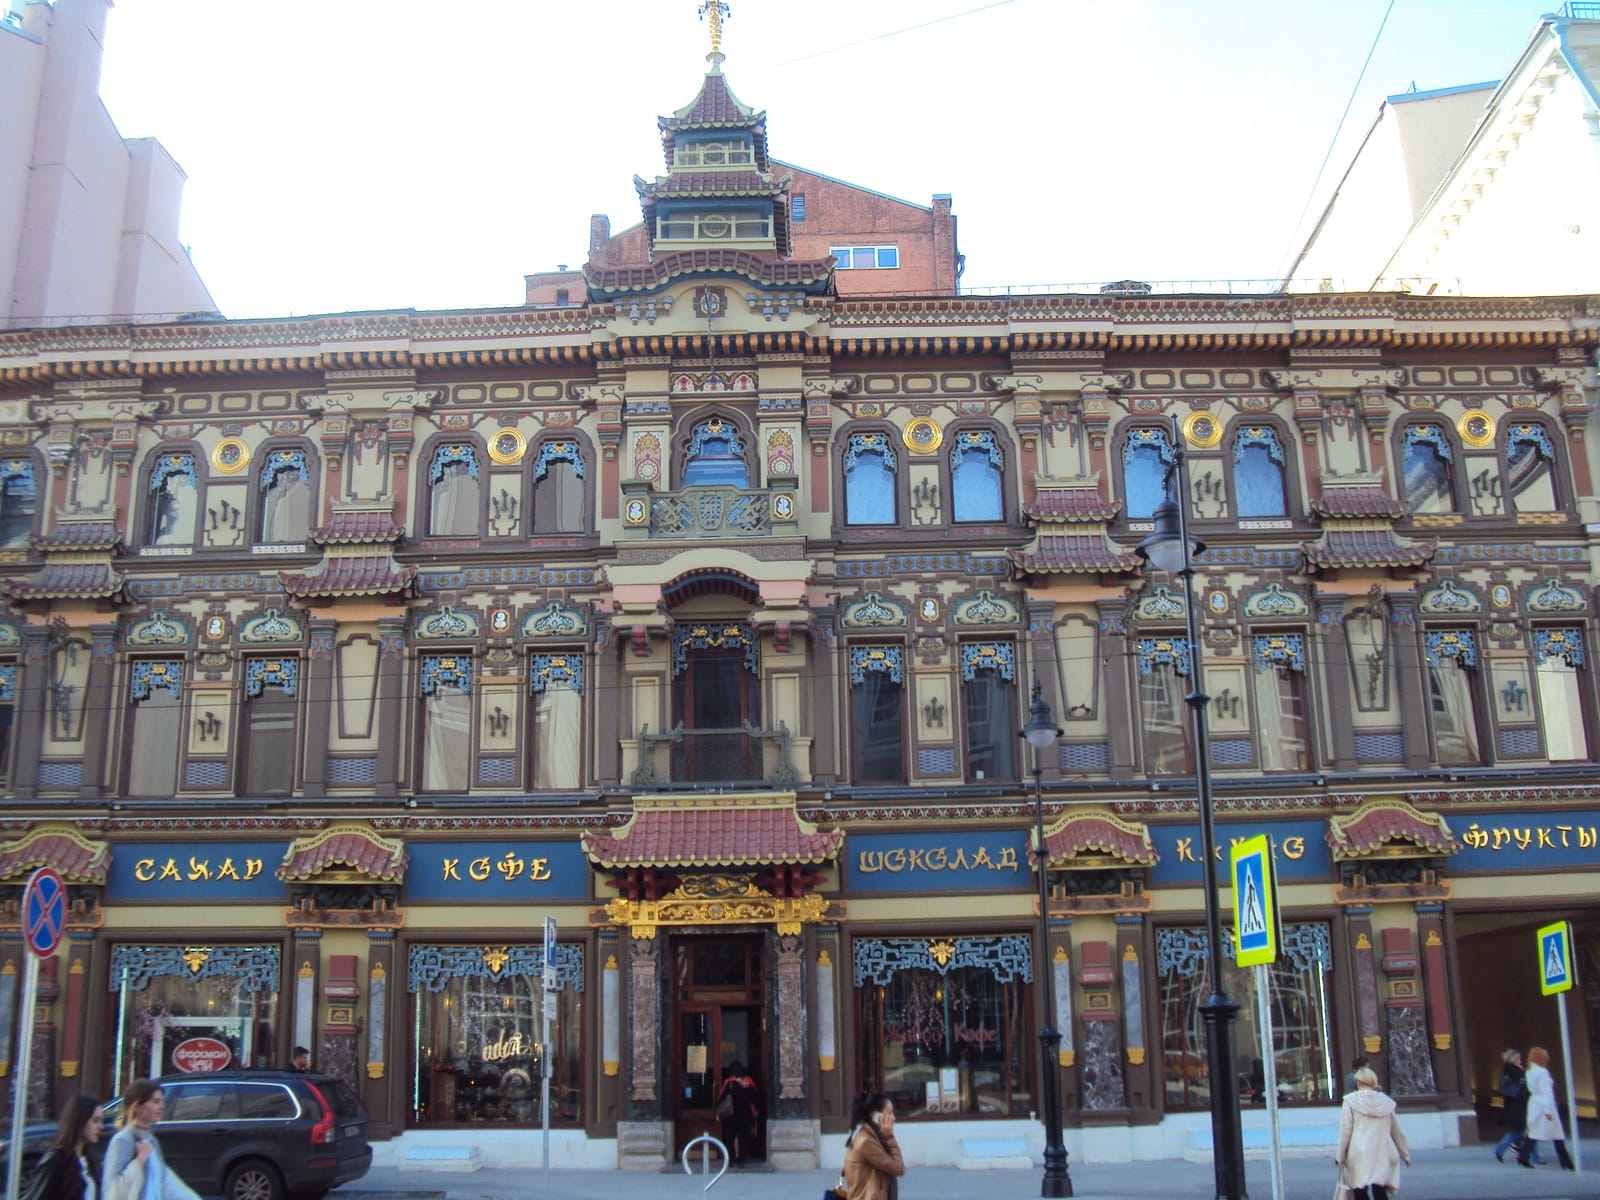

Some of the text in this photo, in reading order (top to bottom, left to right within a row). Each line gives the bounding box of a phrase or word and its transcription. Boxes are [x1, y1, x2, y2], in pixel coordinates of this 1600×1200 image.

[1462, 823, 1598, 851] ФРУКТЫ
[135, 856, 263, 881] САХАР
[443, 851, 552, 881] КОФЕ
[859, 846, 1019, 873] ШОКОЛАД
